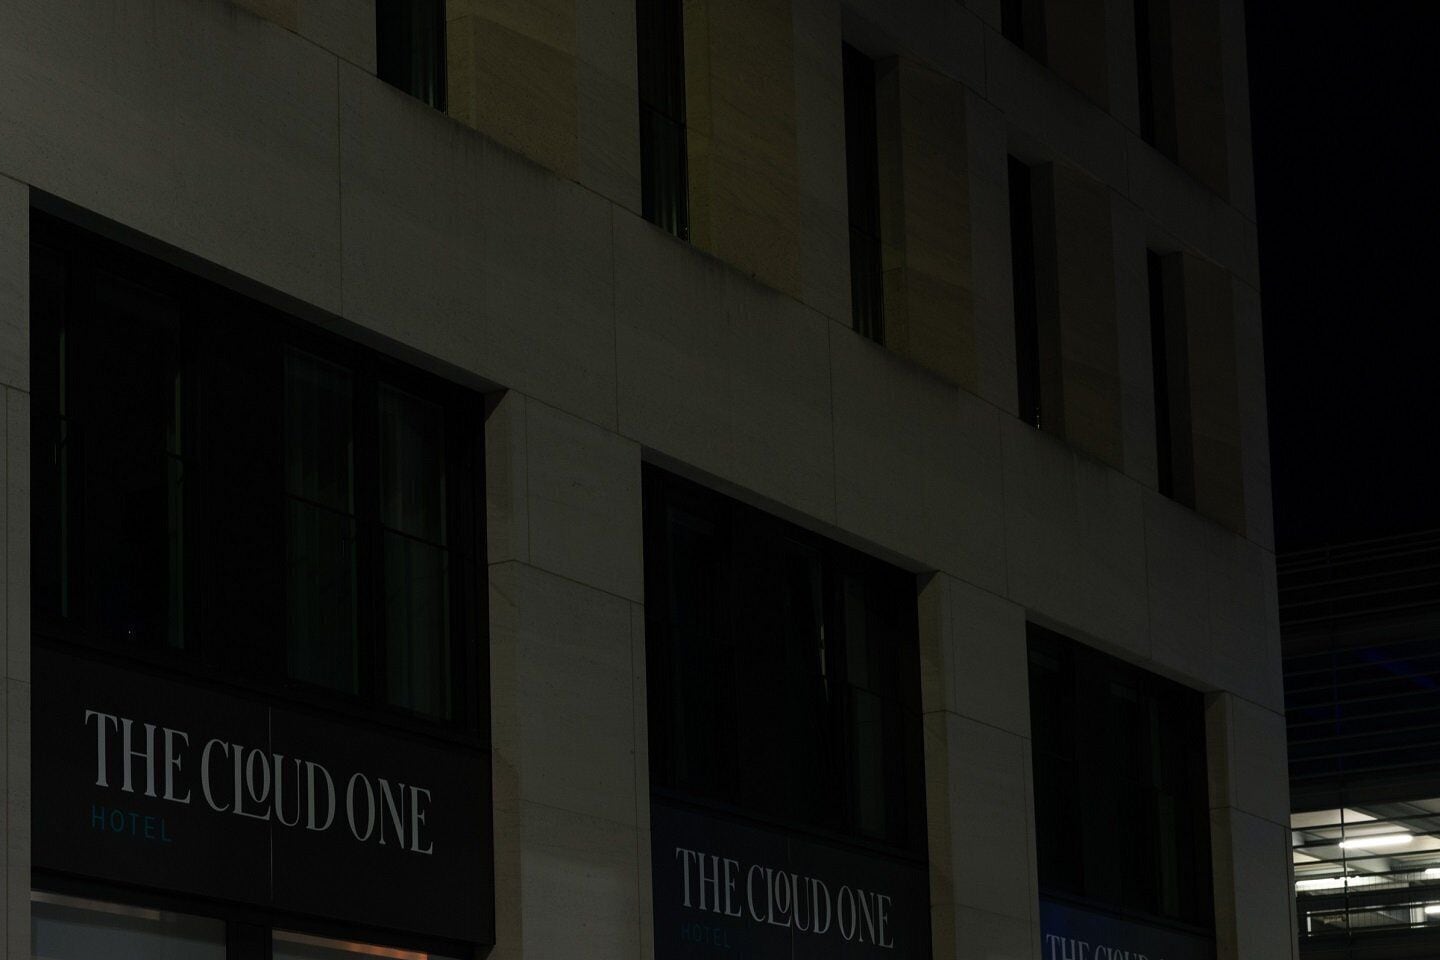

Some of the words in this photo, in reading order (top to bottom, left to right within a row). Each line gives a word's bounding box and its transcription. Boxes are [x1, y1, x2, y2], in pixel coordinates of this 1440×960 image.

[84, 709, 191, 805] THE
[200, 738, 336, 832] CLOUD
[346, 772, 434, 856] ONE
[90, 803, 173, 843] HOTEL
[675, 847, 742, 918] THE
[746, 863, 832, 935] CLOUD
[837, 885, 894, 949] ONE
